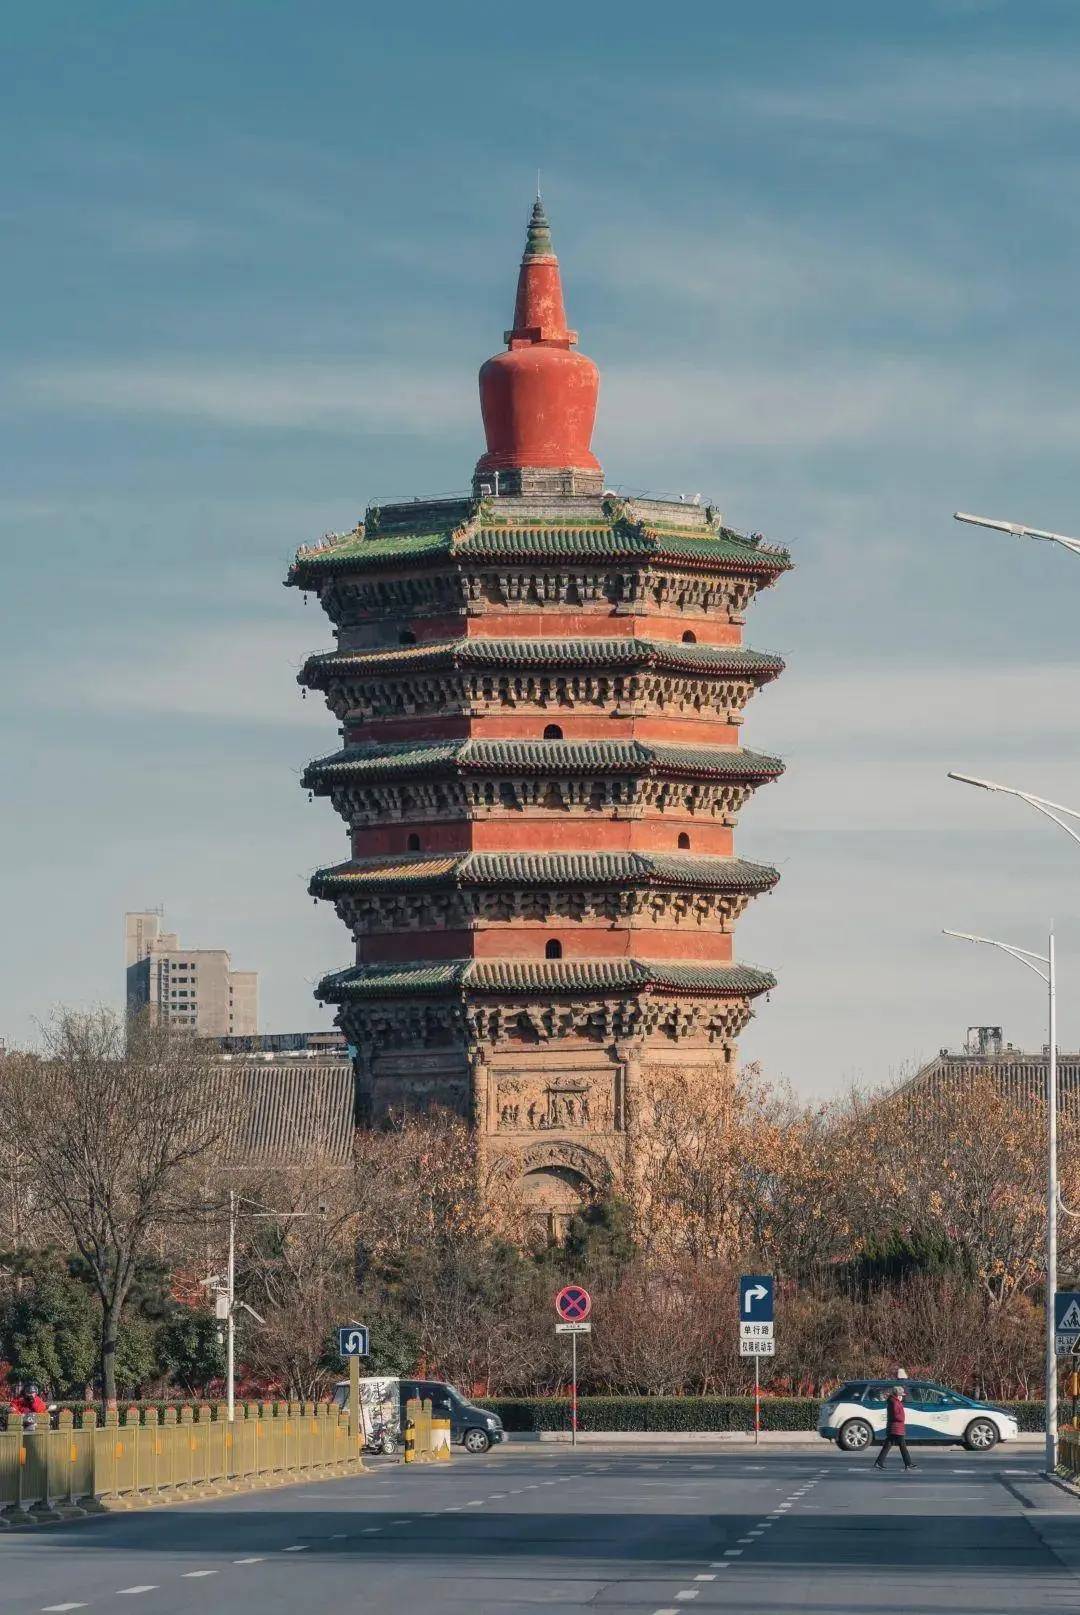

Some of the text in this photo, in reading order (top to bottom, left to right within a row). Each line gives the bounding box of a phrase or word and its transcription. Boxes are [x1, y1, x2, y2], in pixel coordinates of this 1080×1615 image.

[744, 1325, 769, 1335] 单行路
[742, 1341, 773, 1352] 仅限机动车
